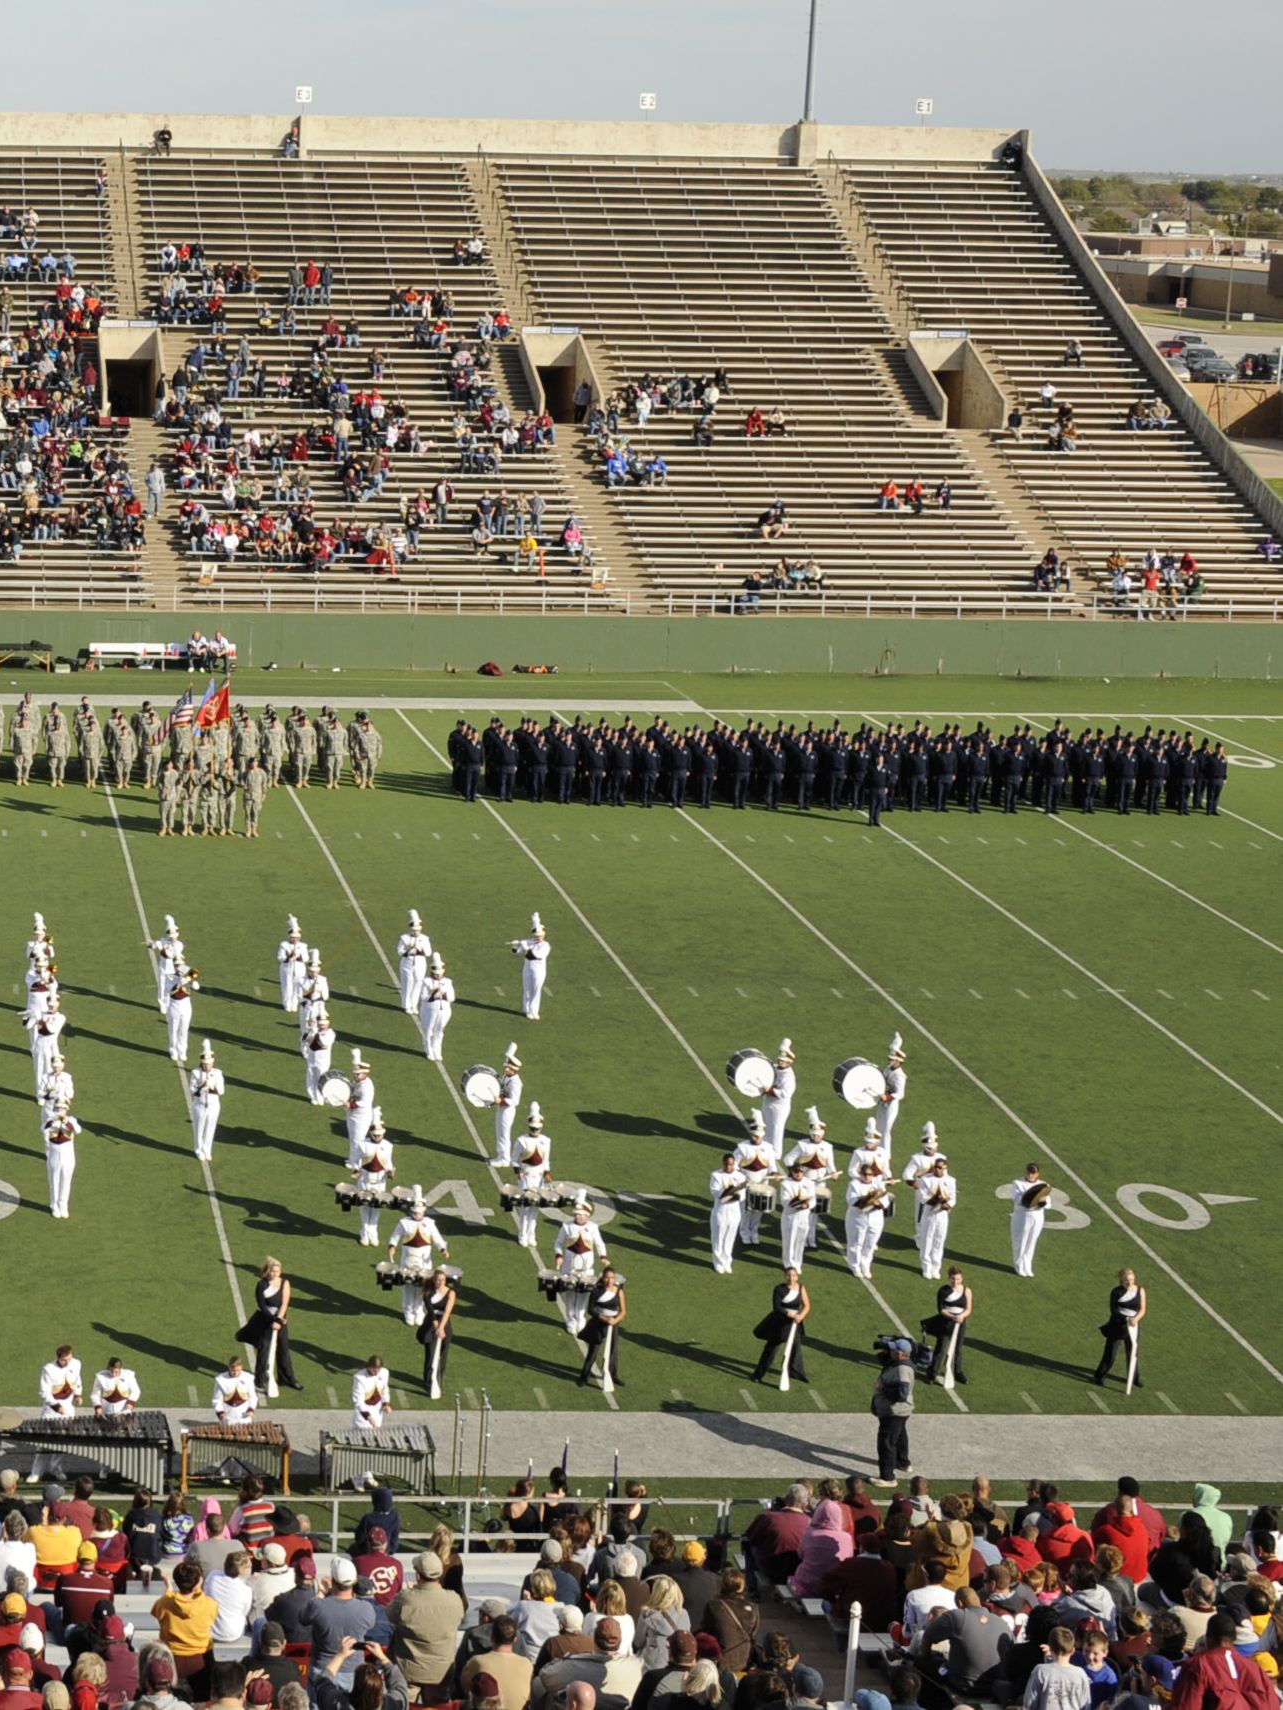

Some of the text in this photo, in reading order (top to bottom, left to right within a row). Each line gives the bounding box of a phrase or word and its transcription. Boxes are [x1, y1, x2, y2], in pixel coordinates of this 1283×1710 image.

[298, 90, 311, 100] E3
[642, 96, 655, 107] E2
[918, 101, 931, 112] E1
[995, 1183, 1211, 1230] 30
